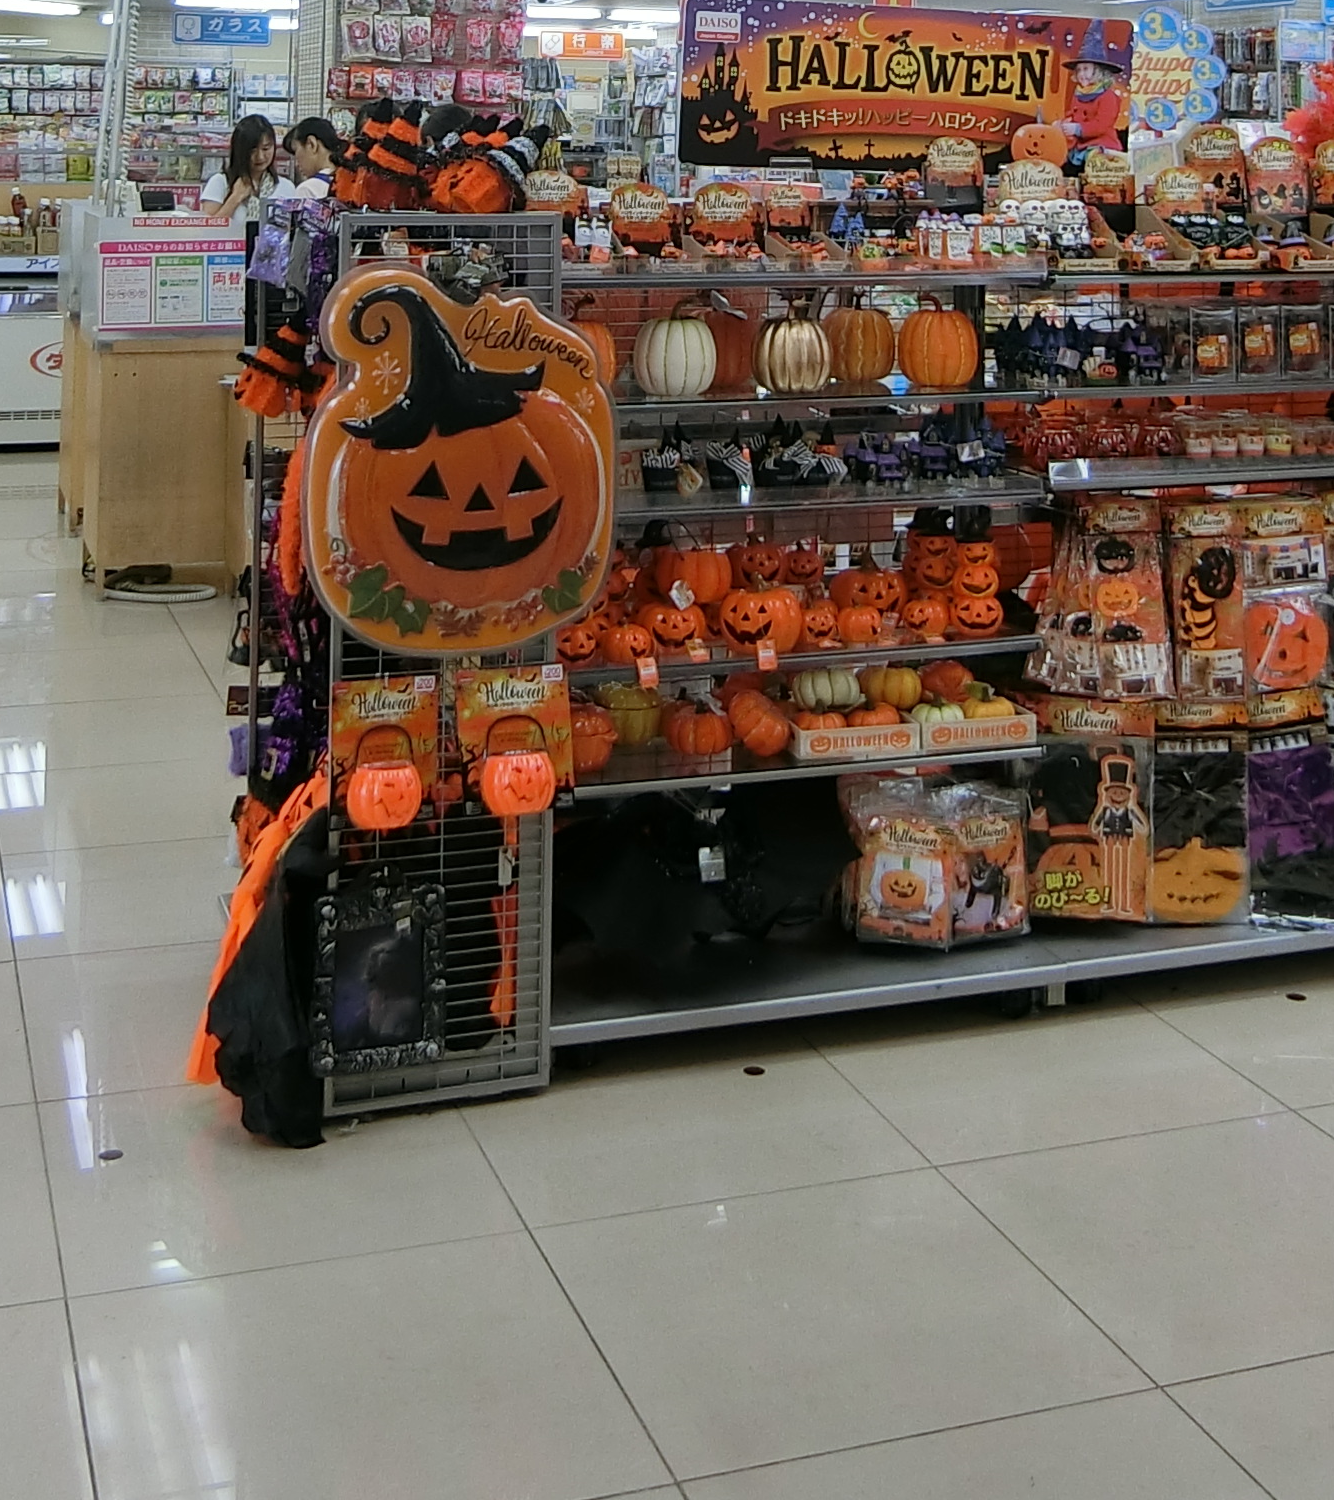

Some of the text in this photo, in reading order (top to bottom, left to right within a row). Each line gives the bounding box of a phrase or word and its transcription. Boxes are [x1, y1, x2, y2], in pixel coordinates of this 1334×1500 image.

[208, 16, 263, 33] ガラス
[699, 16, 738, 29] DAISO
[572, 33, 616, 49] 行楽
[766, 35, 1050, 101] HALLOWEEN
[1131, 52, 1194, 77] Chupa
[1129, 74, 1192, 97] Chups
[1001, 171, 1059, 190] Halloween
[617, 192, 666, 210] Halloween
[698, 191, 749, 210] Halloween
[171, 218, 207, 226] EXCHANGE
[213, 271, 241, 285] 両替
[463, 306, 594, 380] Halloween
[478, 679, 547, 703] Halloween
[351, 692, 417, 714] Halloween
[1054, 708, 1118, 731] Halloween
[884, 825, 939, 849] Halloween
[1046, 871, 1083, 890] 脚が
